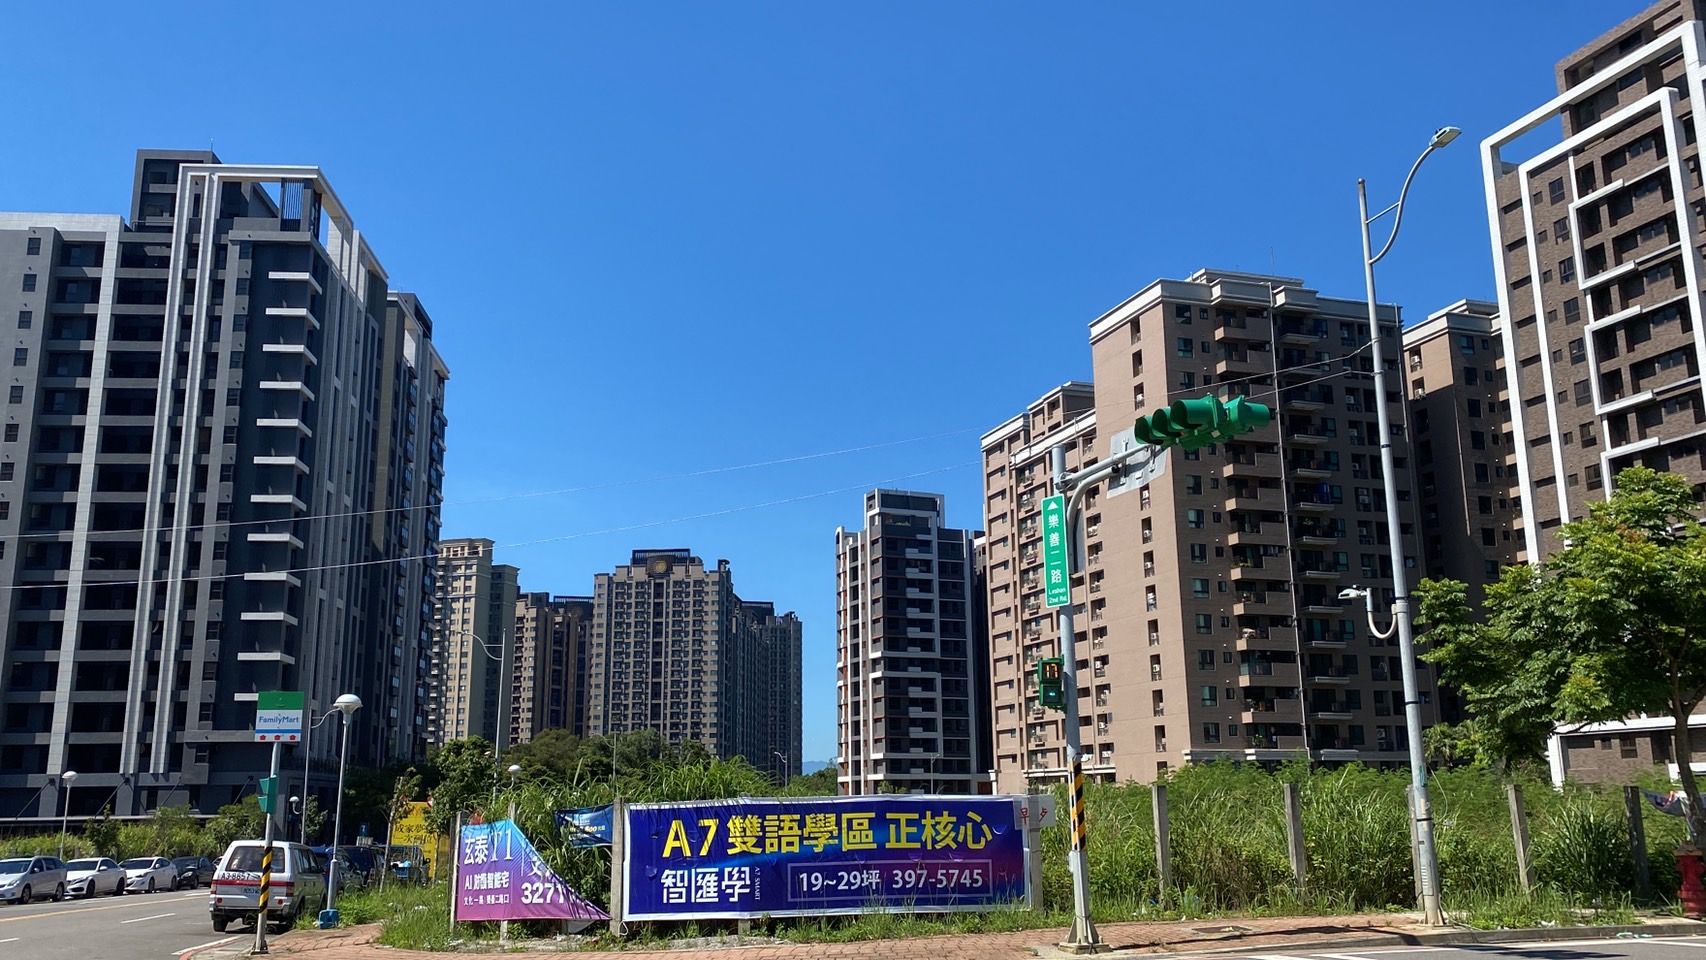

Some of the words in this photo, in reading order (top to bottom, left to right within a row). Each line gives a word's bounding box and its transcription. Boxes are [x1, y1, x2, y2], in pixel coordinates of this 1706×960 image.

[1048, 513, 1062, 585] 樂善二路
[258, 715, 299, 724] FamilyMart
[662, 819, 719, 857] A7
[726, 812, 877, 855] 雙語學區
[885, 810, 993, 850] 正核心
[799, 870, 881, 892] 19~29坪
[892, 869, 983, 889] 397-5745
